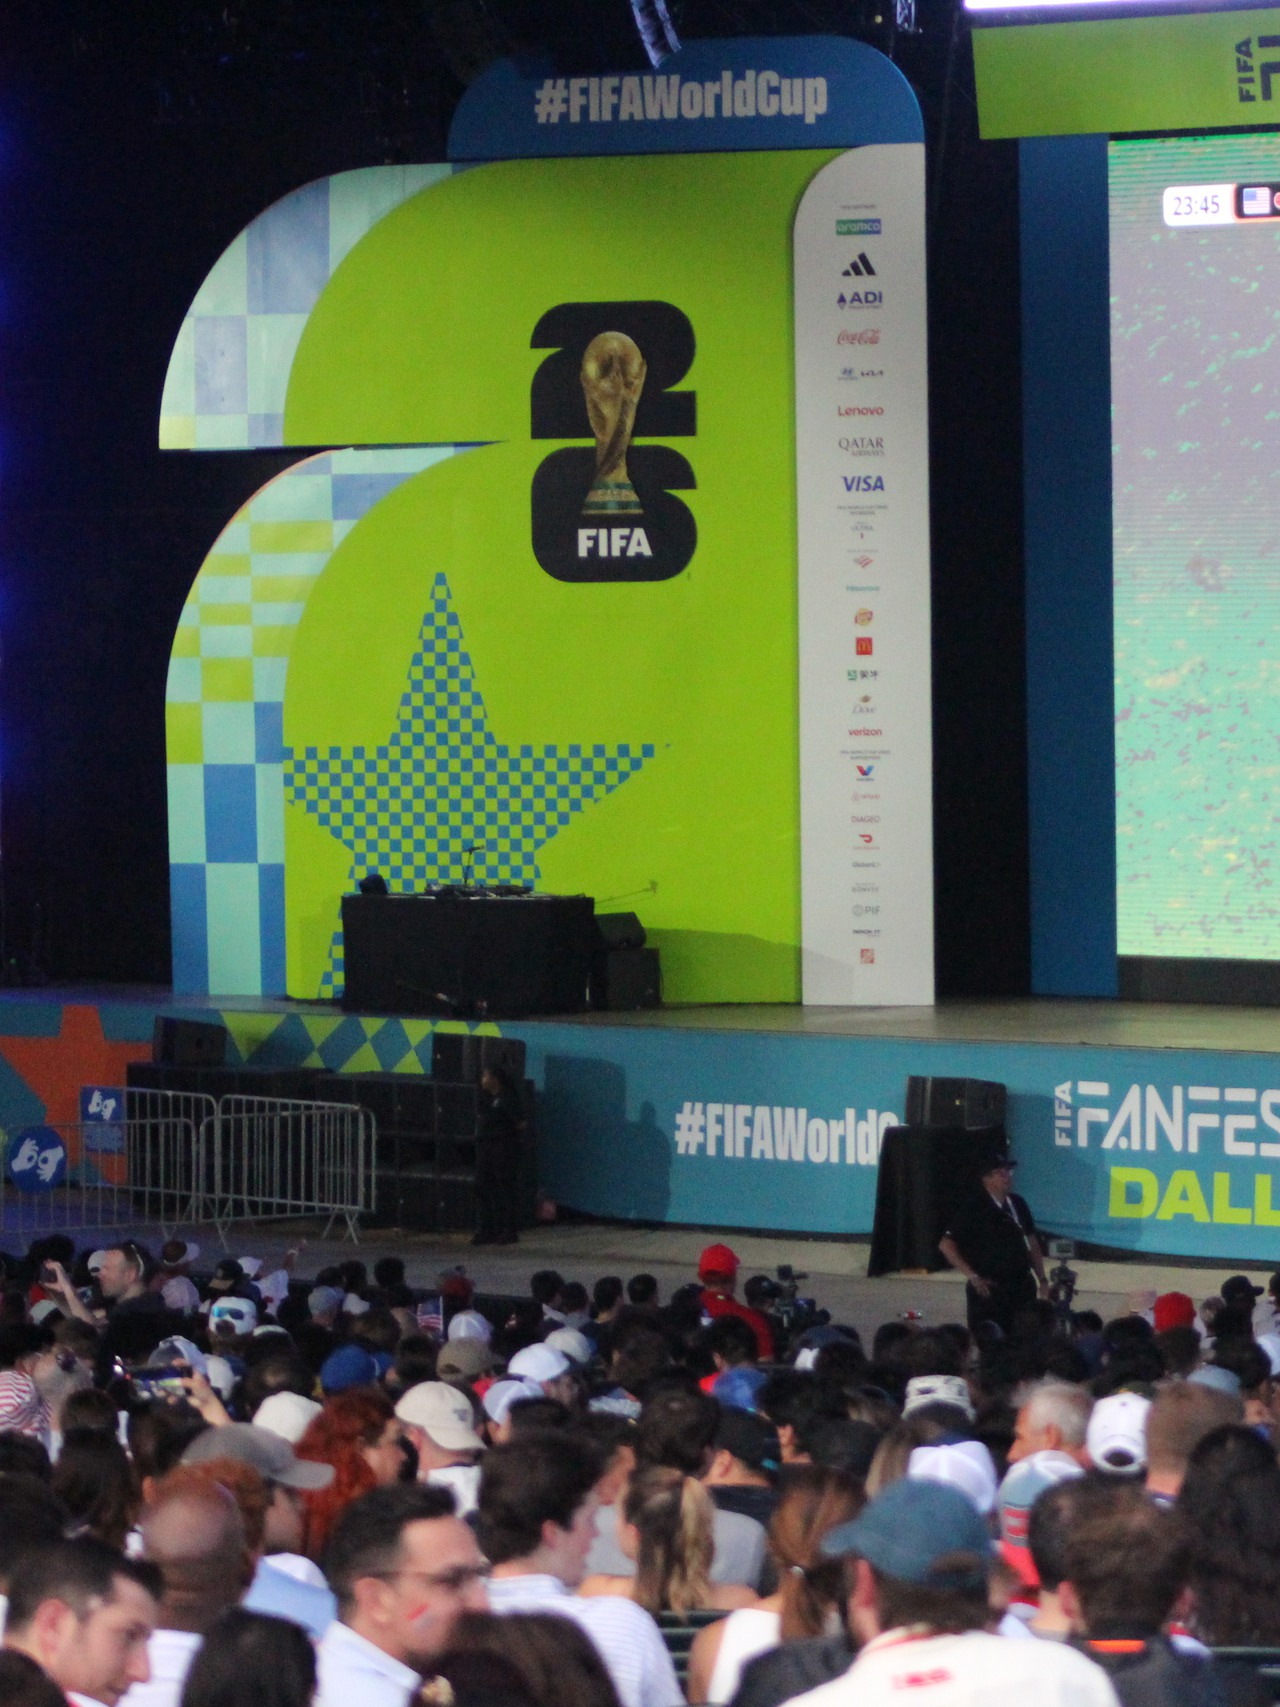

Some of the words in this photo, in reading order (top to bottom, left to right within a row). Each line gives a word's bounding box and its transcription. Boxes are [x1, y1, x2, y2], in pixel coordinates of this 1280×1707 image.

[1238, 37, 1254, 102] FIFA
[534, 70, 828, 124] #FIFAWorldCup
[1173, 195, 1220, 216] 23:45
[850, 291, 882, 304] ADI
[838, 406, 884, 416] Lenovo
[838, 437, 884, 451] QATAR
[842, 475, 885, 492] VISA
[578, 527, 652, 557] FIFA
[848, 727, 882, 736] verizon
[1054, 1080, 1072, 1146] FIFA
